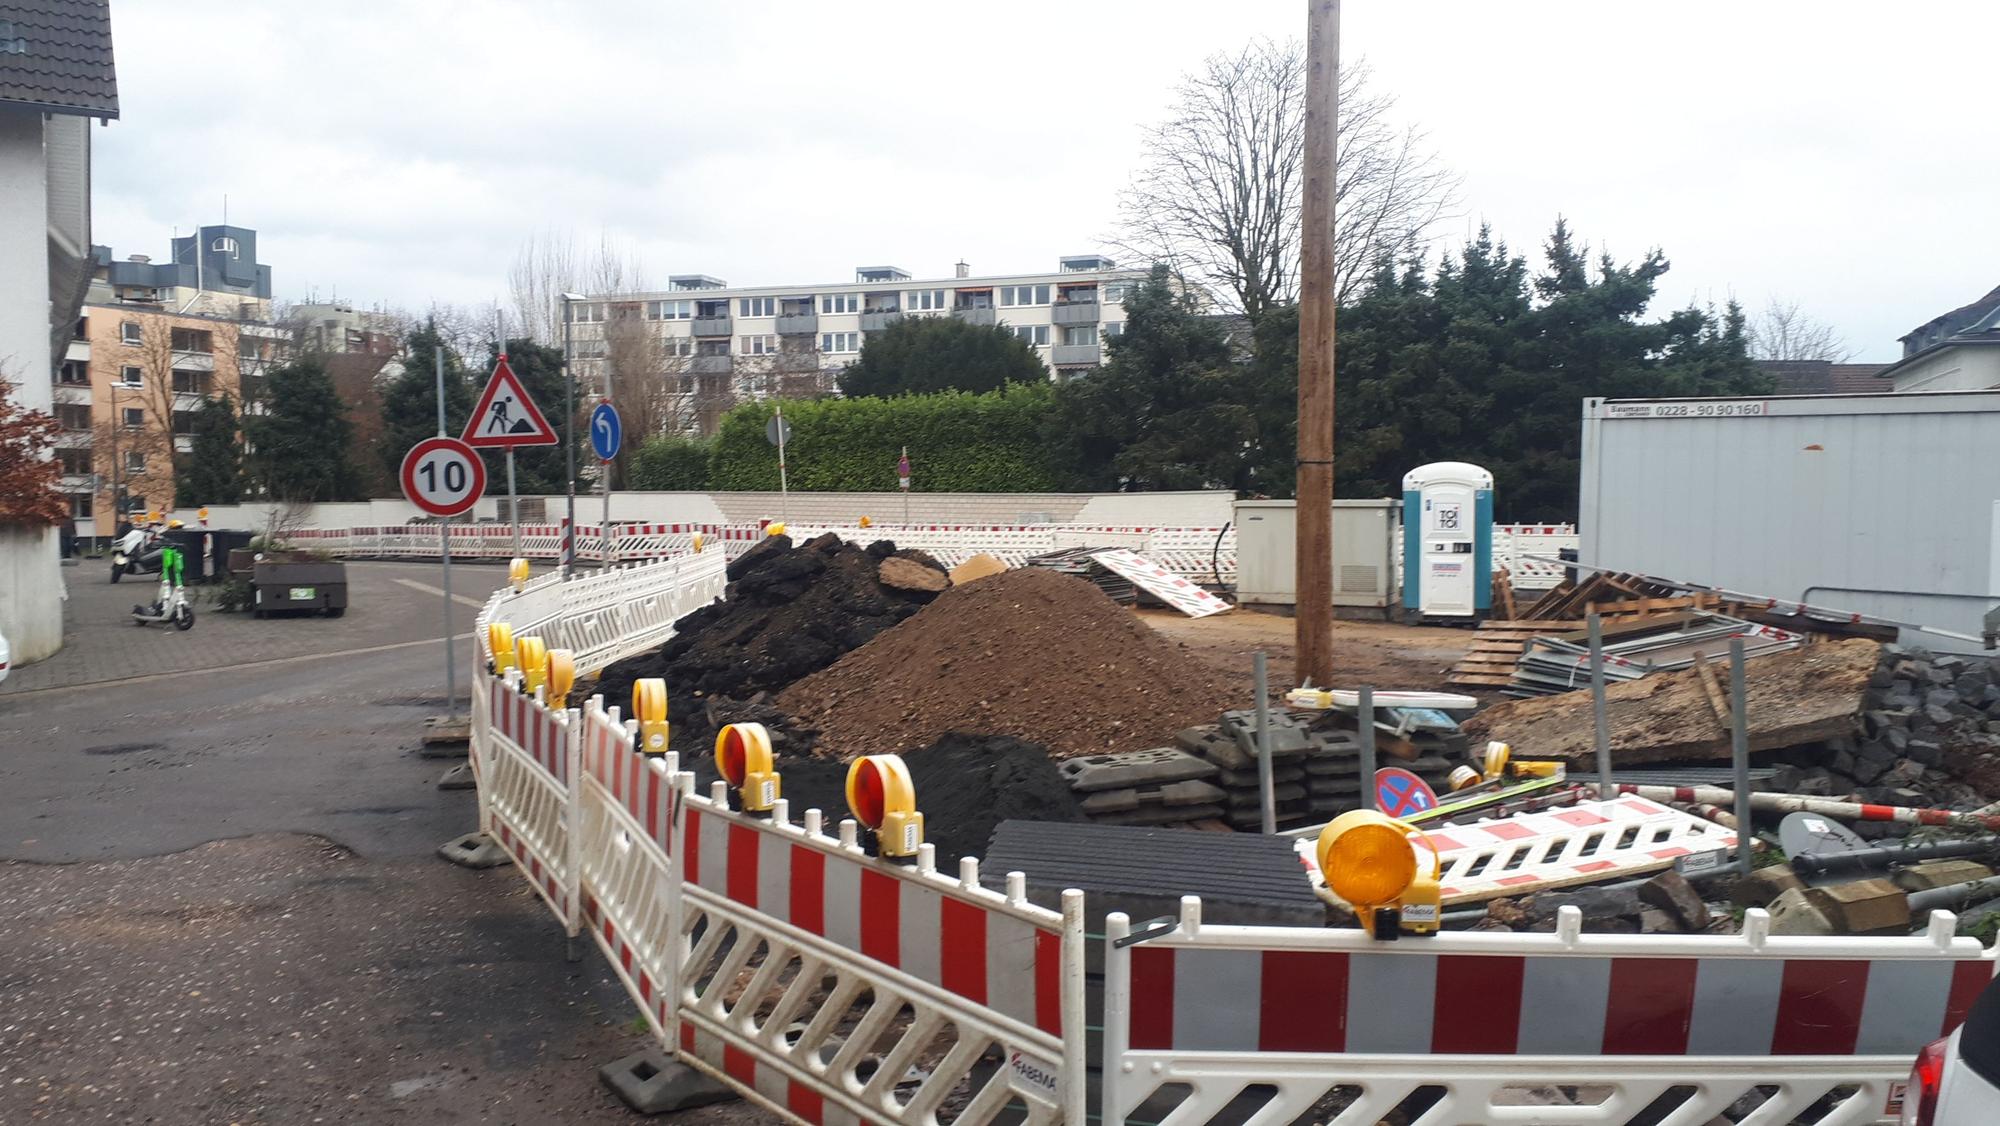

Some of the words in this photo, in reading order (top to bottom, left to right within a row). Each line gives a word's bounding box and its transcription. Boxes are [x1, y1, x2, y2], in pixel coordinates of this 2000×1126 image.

[1655, 405, 1688, 416] 0228
[1737, 403, 1762, 415] 160
[420, 461, 466, 493] 10
